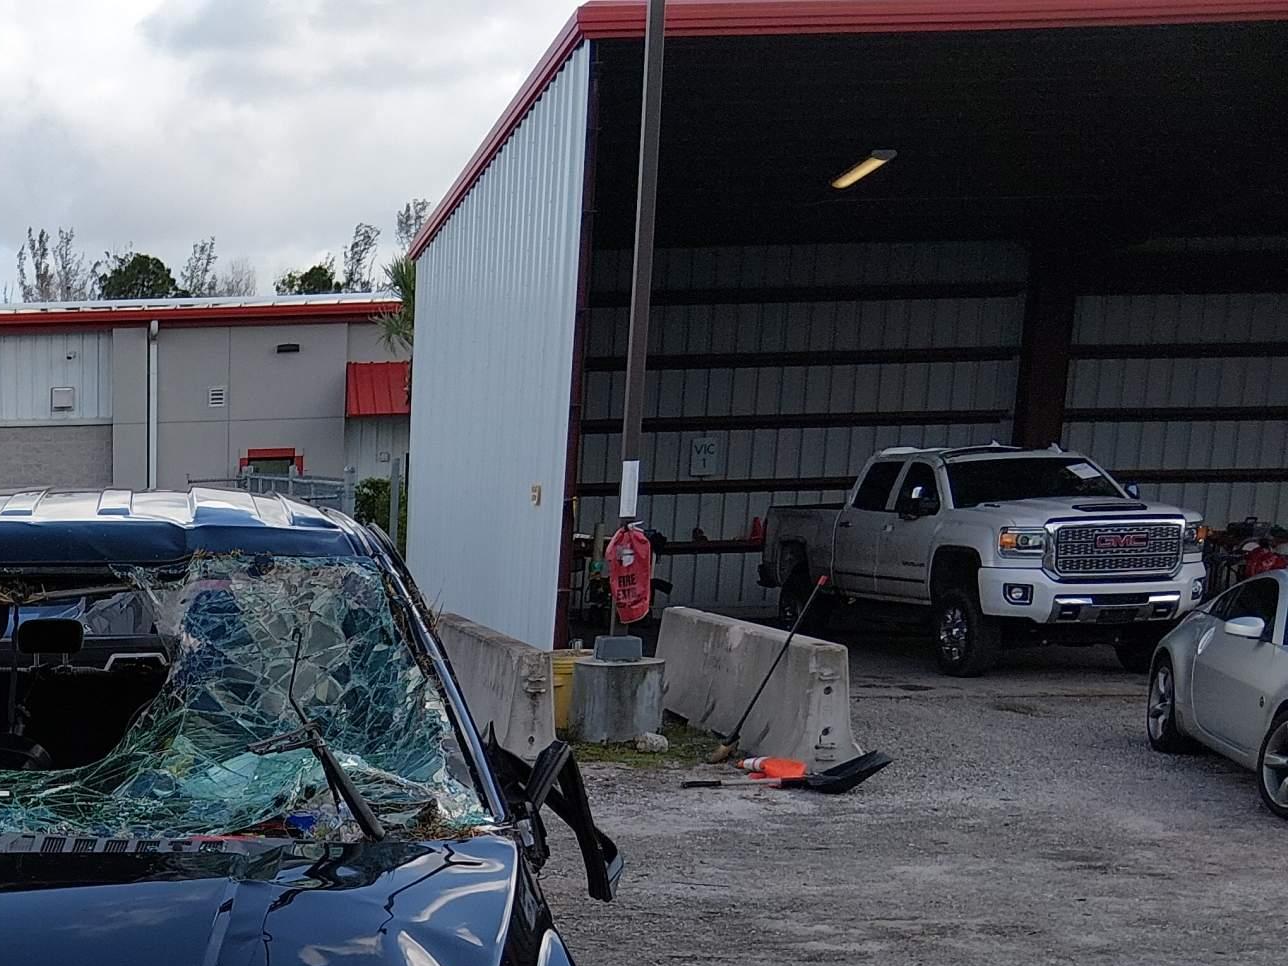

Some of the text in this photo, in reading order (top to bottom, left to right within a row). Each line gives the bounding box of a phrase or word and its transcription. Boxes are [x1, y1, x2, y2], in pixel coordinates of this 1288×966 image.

[694, 443, 715, 455] VIC
[1096, 534, 1147, 548] GMC
[617, 573, 637, 588] FIRE
